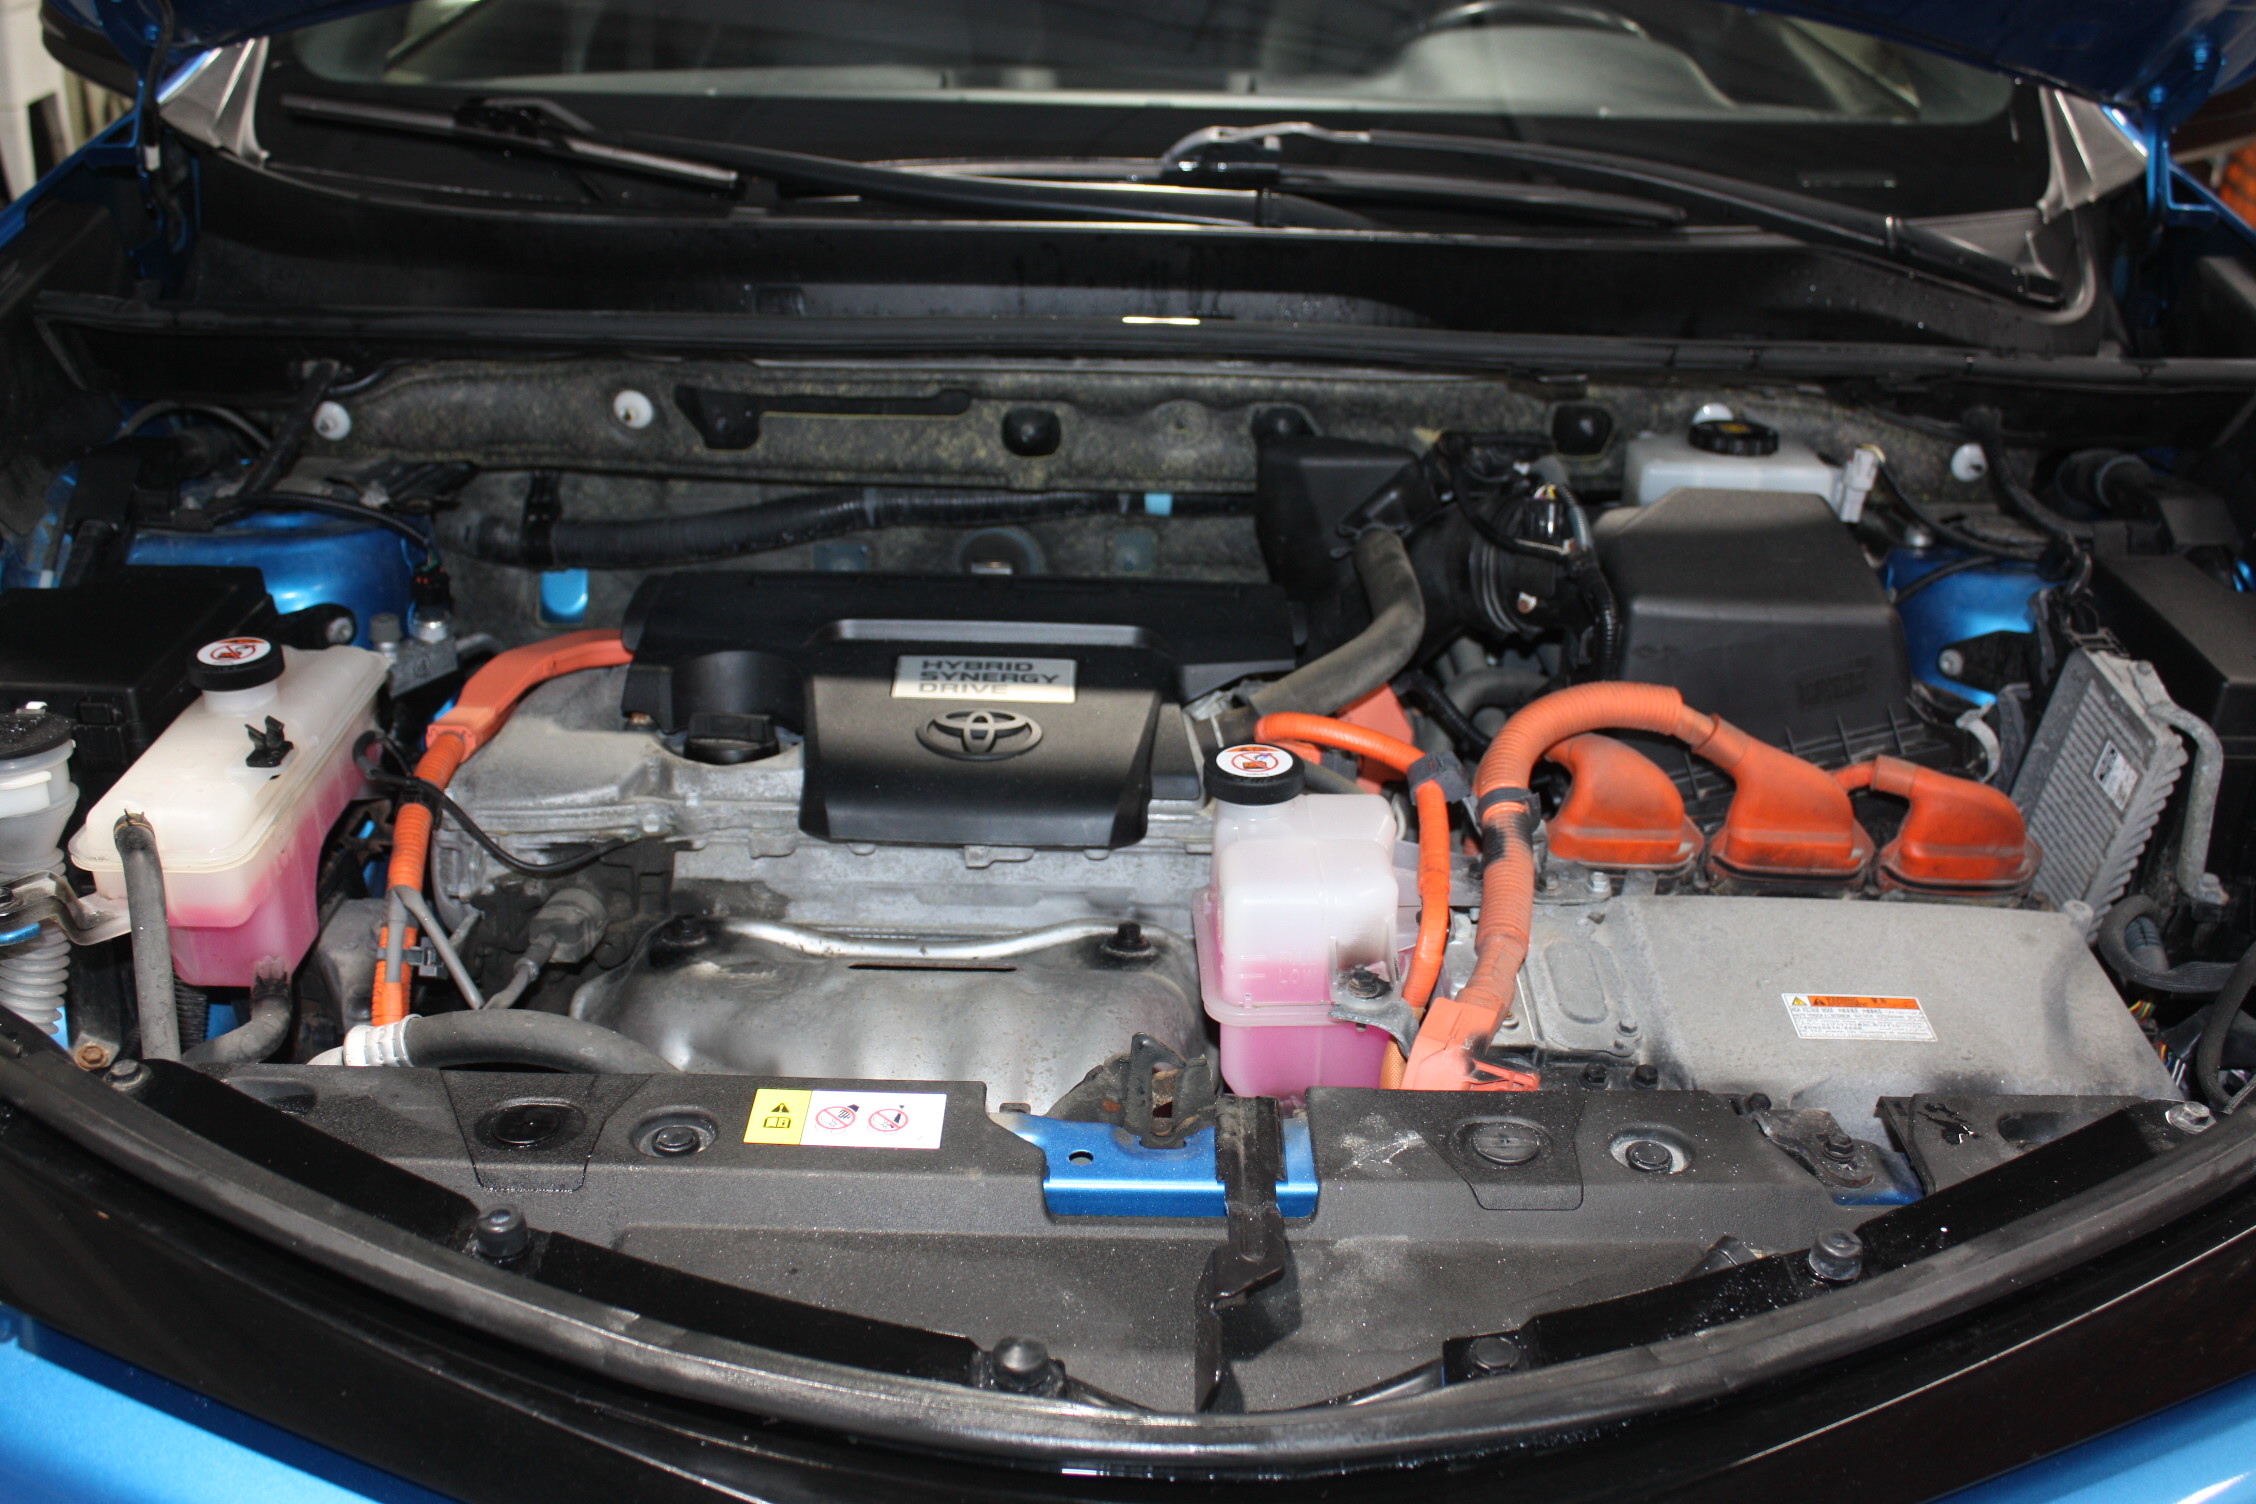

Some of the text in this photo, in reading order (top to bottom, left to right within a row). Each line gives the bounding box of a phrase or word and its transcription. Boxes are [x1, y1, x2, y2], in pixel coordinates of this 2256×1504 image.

[922, 660, 1034, 671] HYBRID
[920, 671, 1060, 684] SYNERGY
[918, 683, 1009, 694] DRIVE
